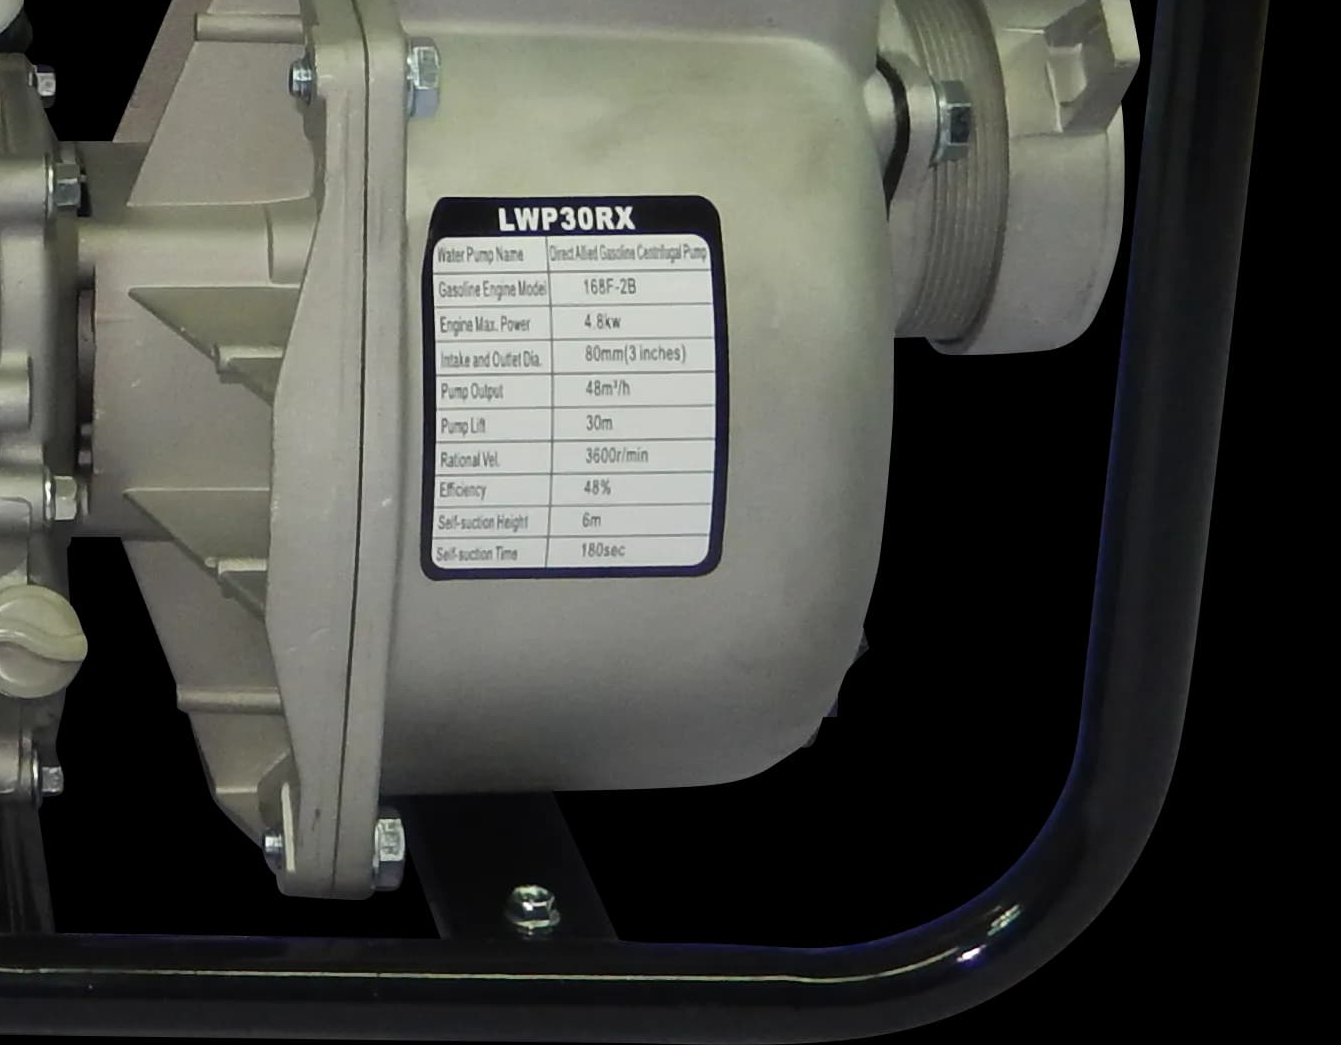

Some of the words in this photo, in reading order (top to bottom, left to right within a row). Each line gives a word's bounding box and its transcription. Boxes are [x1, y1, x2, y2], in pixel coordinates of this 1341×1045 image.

[498, 206, 636, 232] LWP30RX
[437, 247, 465, 263] Water
[466, 246, 494, 265] Pump
[496, 246, 524, 262] Name
[550, 245, 574, 261] Direct
[575, 245, 598, 261] Allied
[600, 245, 636, 261] Gasoline
[637, 244, 682, 263] Centrifugal
[683, 243, 707, 263] Pump
[438, 281, 481, 298] Gasoline
[483, 281, 516, 301] Engine
[518, 280, 547, 296] Model
[584, 278, 637, 295] 168F-2B
[440, 316, 473, 336] Engine
[475, 316, 498, 332] Max.
[501, 316, 530, 332] Power
[584, 313, 621, 329] 4.8kw
[441, 351, 470, 368] Intake
[472, 351, 491, 368] and
[492, 350, 521, 368] Outlet
[523, 350, 541, 367] Dia.
[585, 344, 636, 364] 80mm(3
[639, 344, 686, 364] inches)
[441, 383, 469, 401] Pump
[471, 382, 504, 401] Output
[441, 417, 469, 436] Pump
[470, 417, 486, 434] Lift
[585, 414, 613, 431] 30m
[440, 451, 481, 468] Rational
[482, 451, 500, 467] Vel.
[585, 446, 649, 464] 3600r/min
[439, 481, 487, 501] Efficiency
[584, 478, 611, 495] 48%
[438, 514, 495, 530] Self-suction
[497, 514, 528, 533] Height
[582, 512, 601, 528] 6m
[436, 546, 493, 562] Self-suction
[496, 545, 518, 561] Time
[581, 542, 626, 557] 180sec
